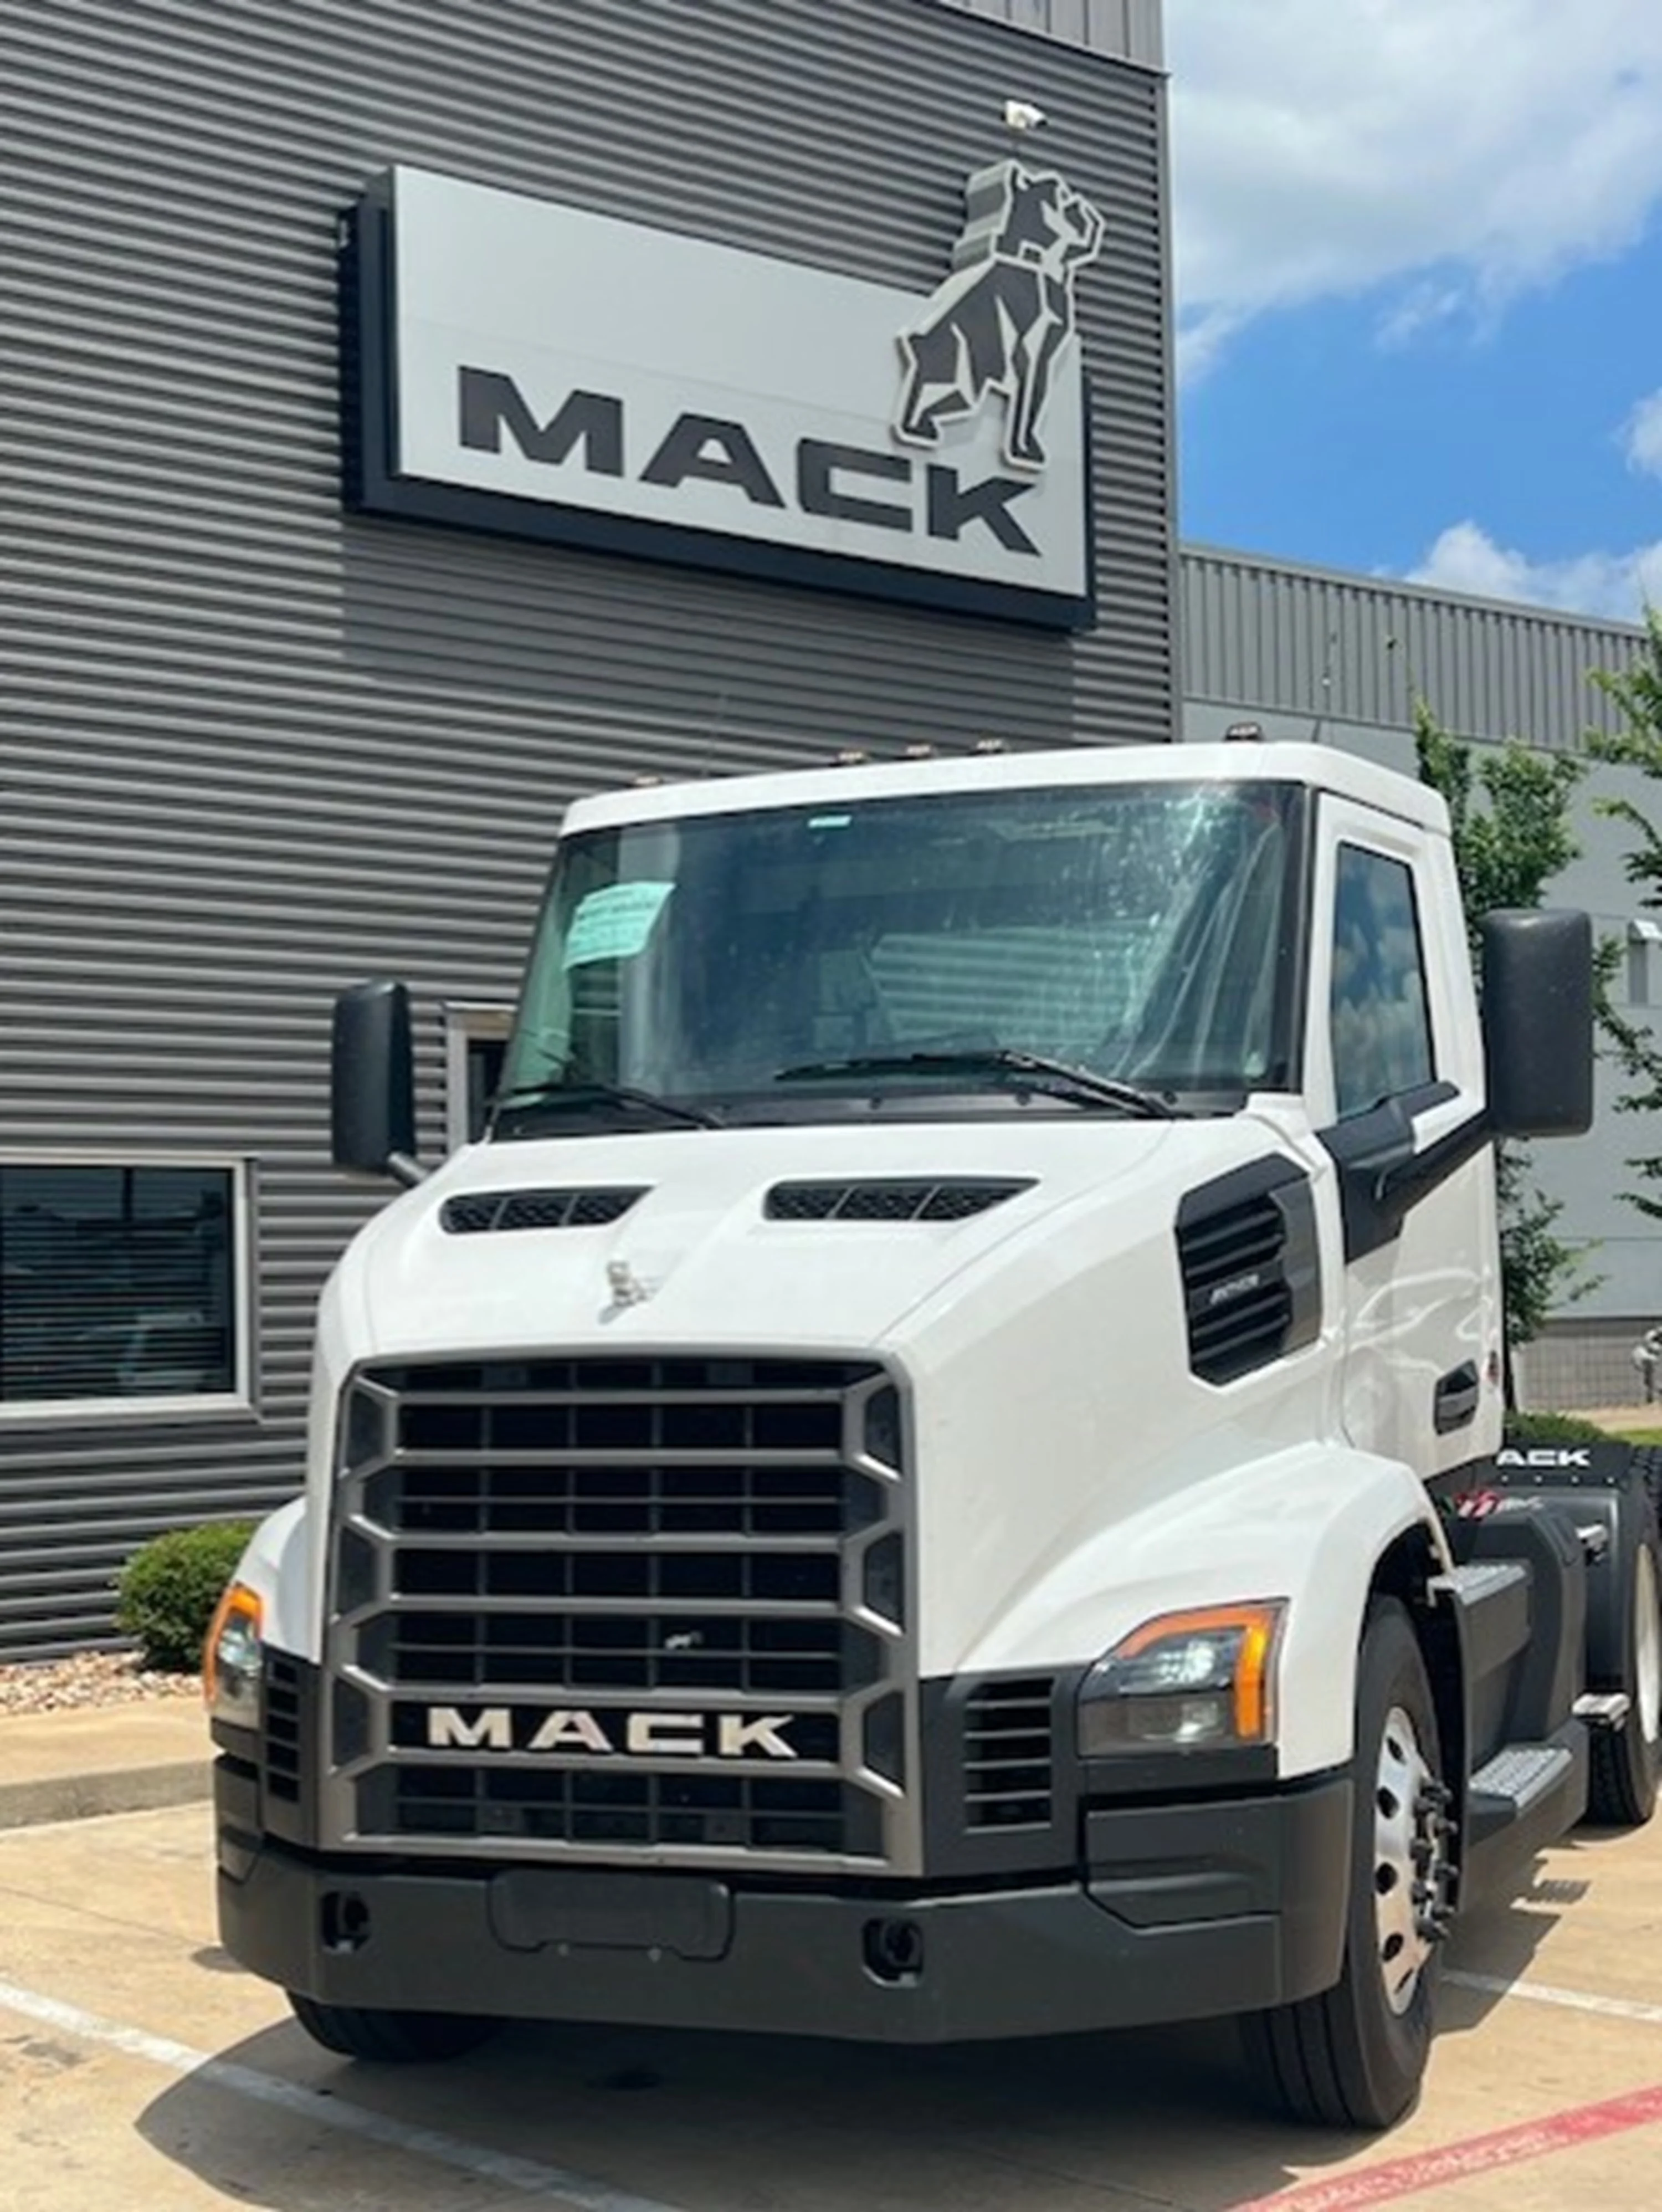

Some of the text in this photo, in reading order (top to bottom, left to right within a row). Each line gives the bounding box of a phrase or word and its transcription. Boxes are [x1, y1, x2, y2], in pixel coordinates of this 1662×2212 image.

[458, 365, 1042, 556] MACK
[1496, 1448, 1591, 1467] ACK
[427, 1707, 797, 1758] MACK
